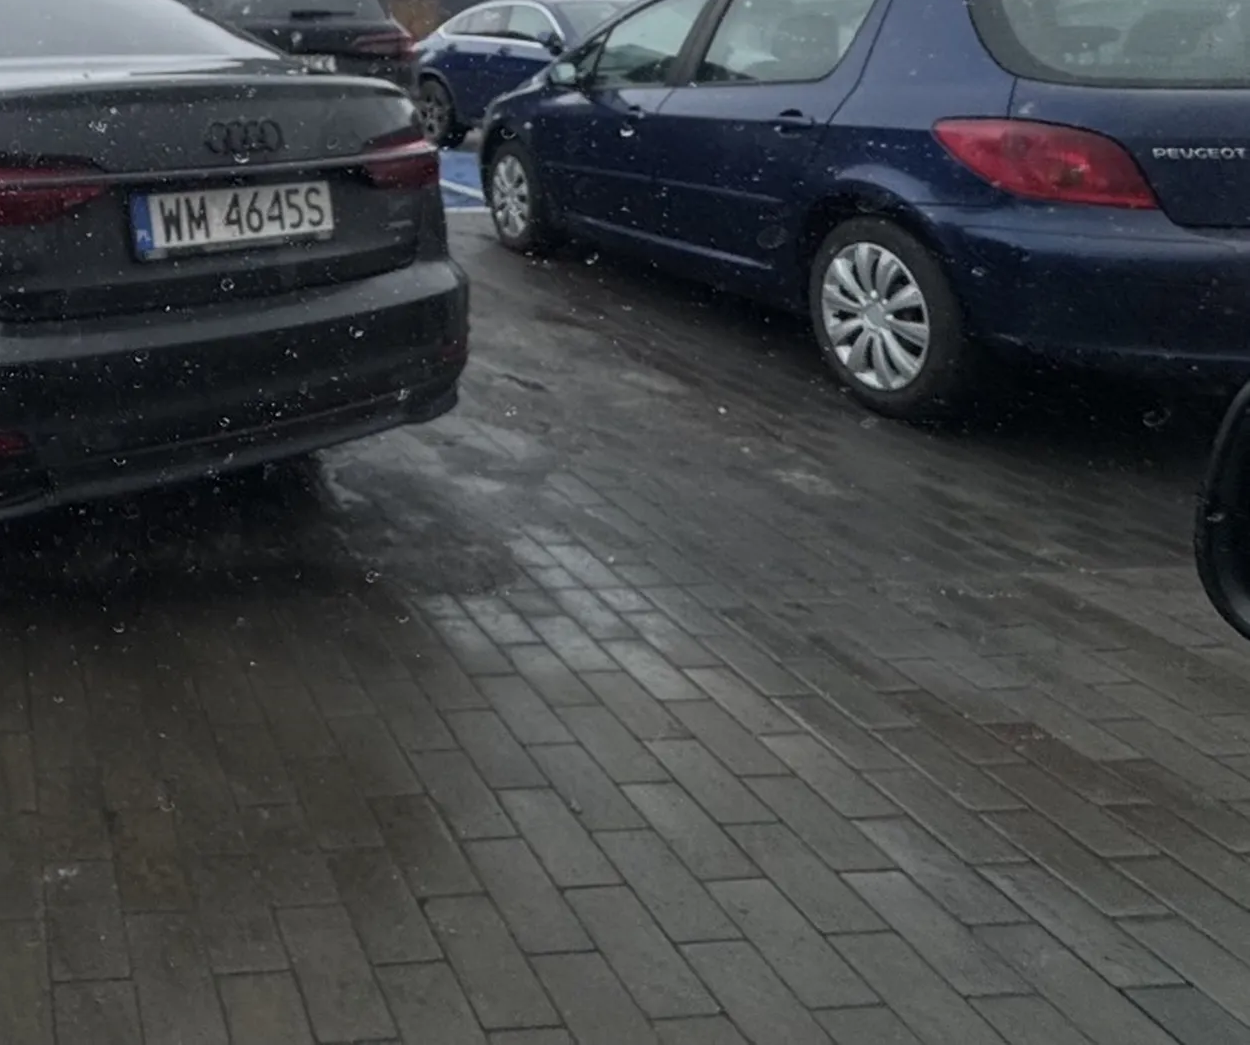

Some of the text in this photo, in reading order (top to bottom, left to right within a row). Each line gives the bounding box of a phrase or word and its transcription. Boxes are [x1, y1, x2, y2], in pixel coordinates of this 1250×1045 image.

[1152, 146, 1246, 160] PEUGEOT
[158, 187, 325, 243] WM 4645S
